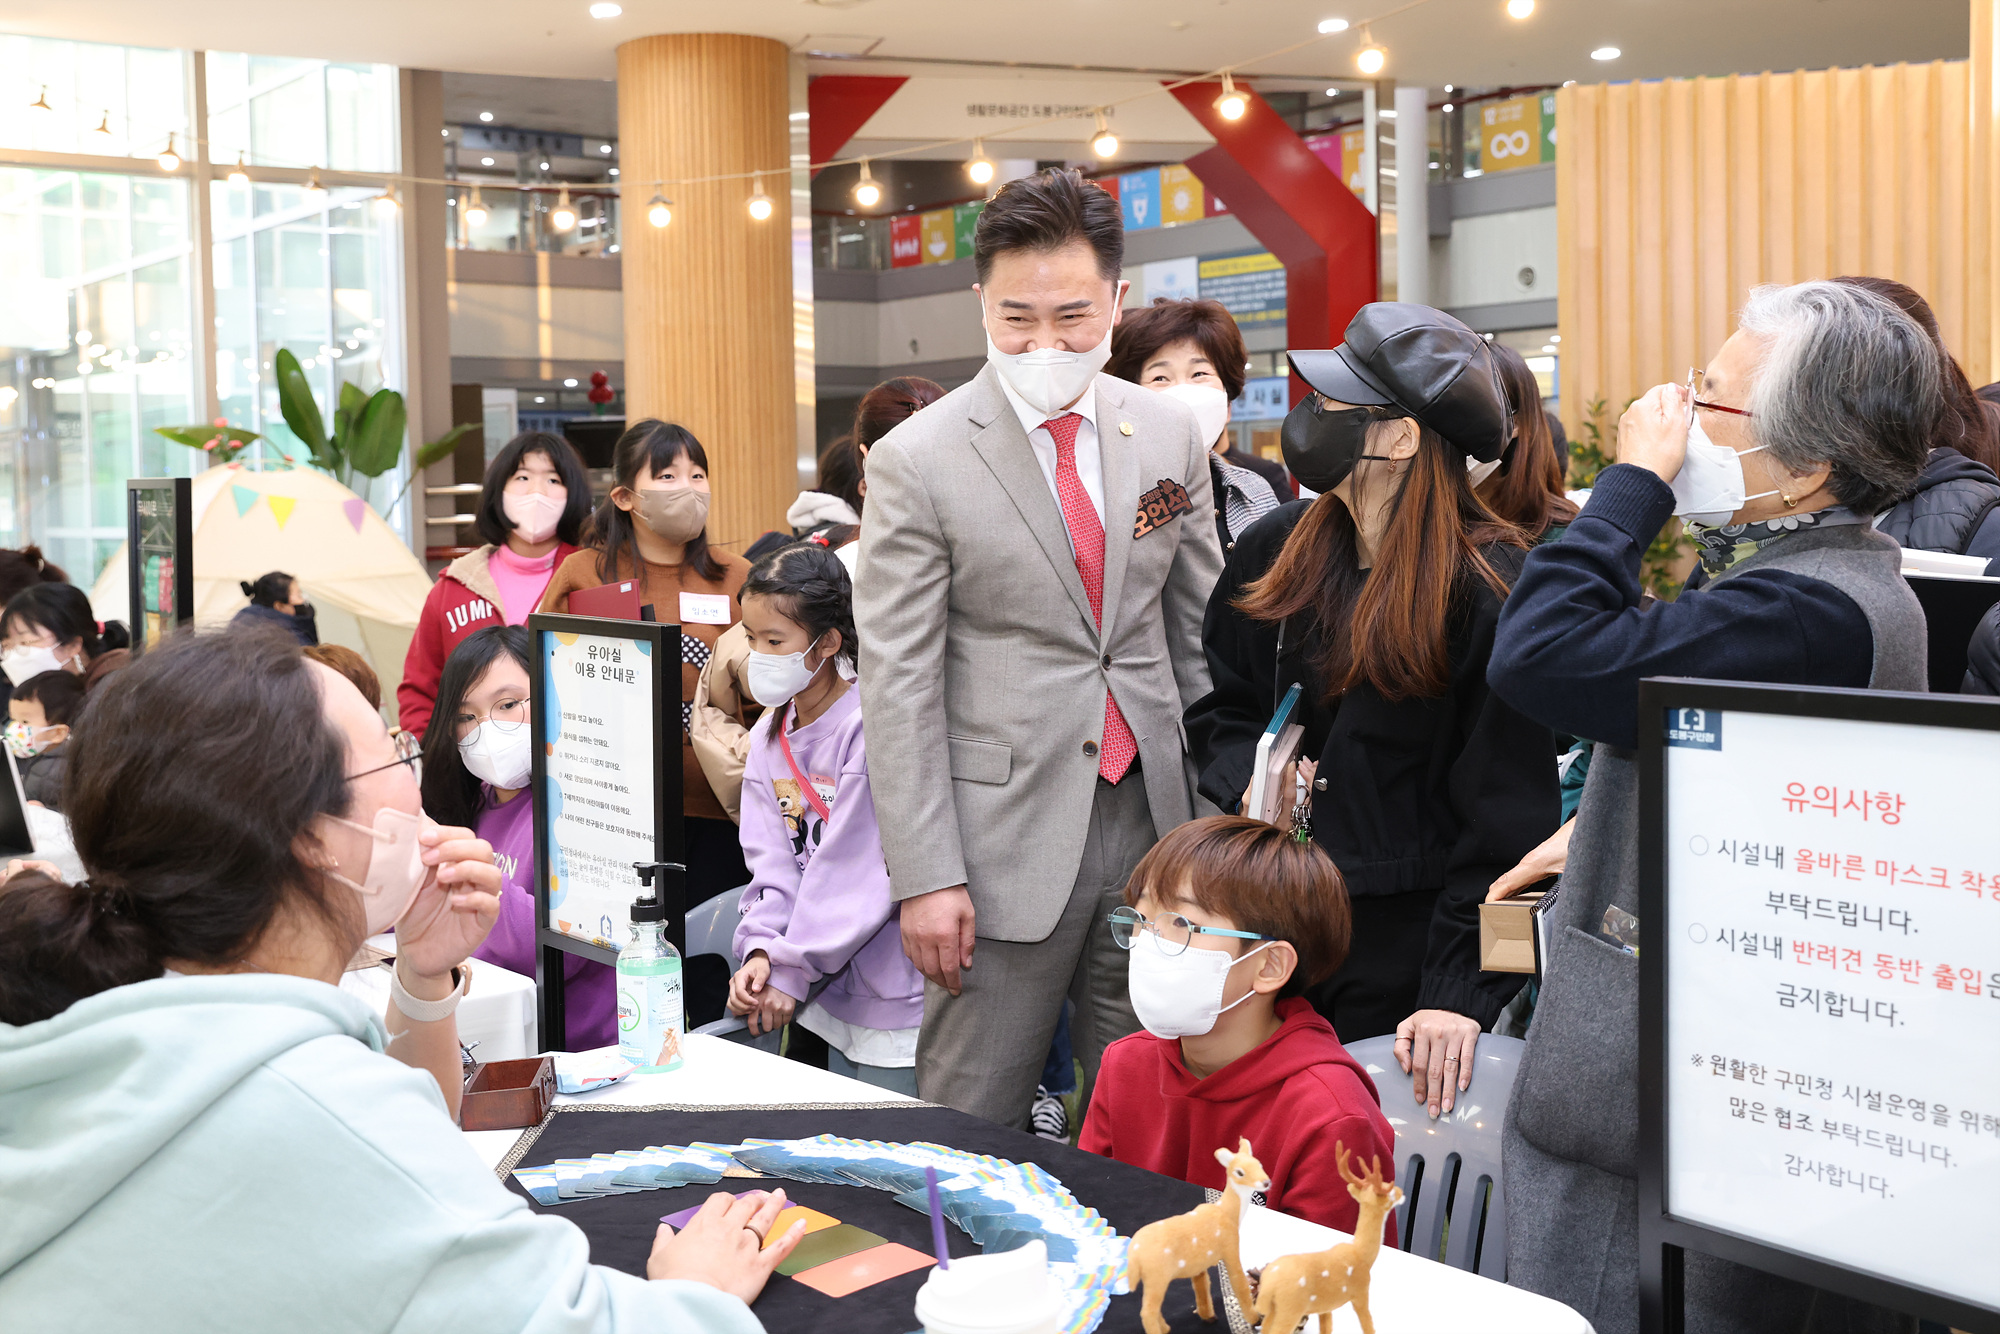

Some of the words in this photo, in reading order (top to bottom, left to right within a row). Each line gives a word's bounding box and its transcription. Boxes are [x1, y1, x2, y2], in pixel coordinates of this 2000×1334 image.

[1135, 487, 1193, 539] 오언석
[575, 662, 596, 678] 이용
[601, 665, 636, 684] 안내문
[587, 645, 622, 663] 유아실
[1669, 729, 1715, 743] 도봉구민청
[564, 772, 573, 781] 서로
[579, 755, 589, 764] 소리
[590, 758, 604, 767] 지르지
[564, 813, 574, 822] 나이
[585, 818, 605, 829] 친구들은
[605, 824, 625, 835] 보호자와
[1782, 782, 1906, 825] 유의사항
[1717, 839, 1785, 869] 시설내
[1794, 848, 1866, 881] 올바른
[1875, 859, 1951, 889] 마스크
[1765, 891, 1919, 935] 부탁드립니다.
[1716, 928, 1783, 960] 시설내
[1793, 939, 1862, 974] 반려견
[1873, 953, 1923, 984] 동반
[1776, 983, 1905, 1027] 금지합니다.
[1709, 1054, 1767, 1085] 원활한
[1774, 1069, 1833, 1101] 구민청
[1842, 1086, 1952, 1128] 시설운영을
[1959, 1110, 2000, 1138] 위해
[1730, 1096, 1767, 1124] 많은
[1774, 1107, 1815, 1132] 협조
[1821, 1119, 1958, 1168] 부탁드립니다.
[1784, 1153, 1894, 1199] 감사합니다.
